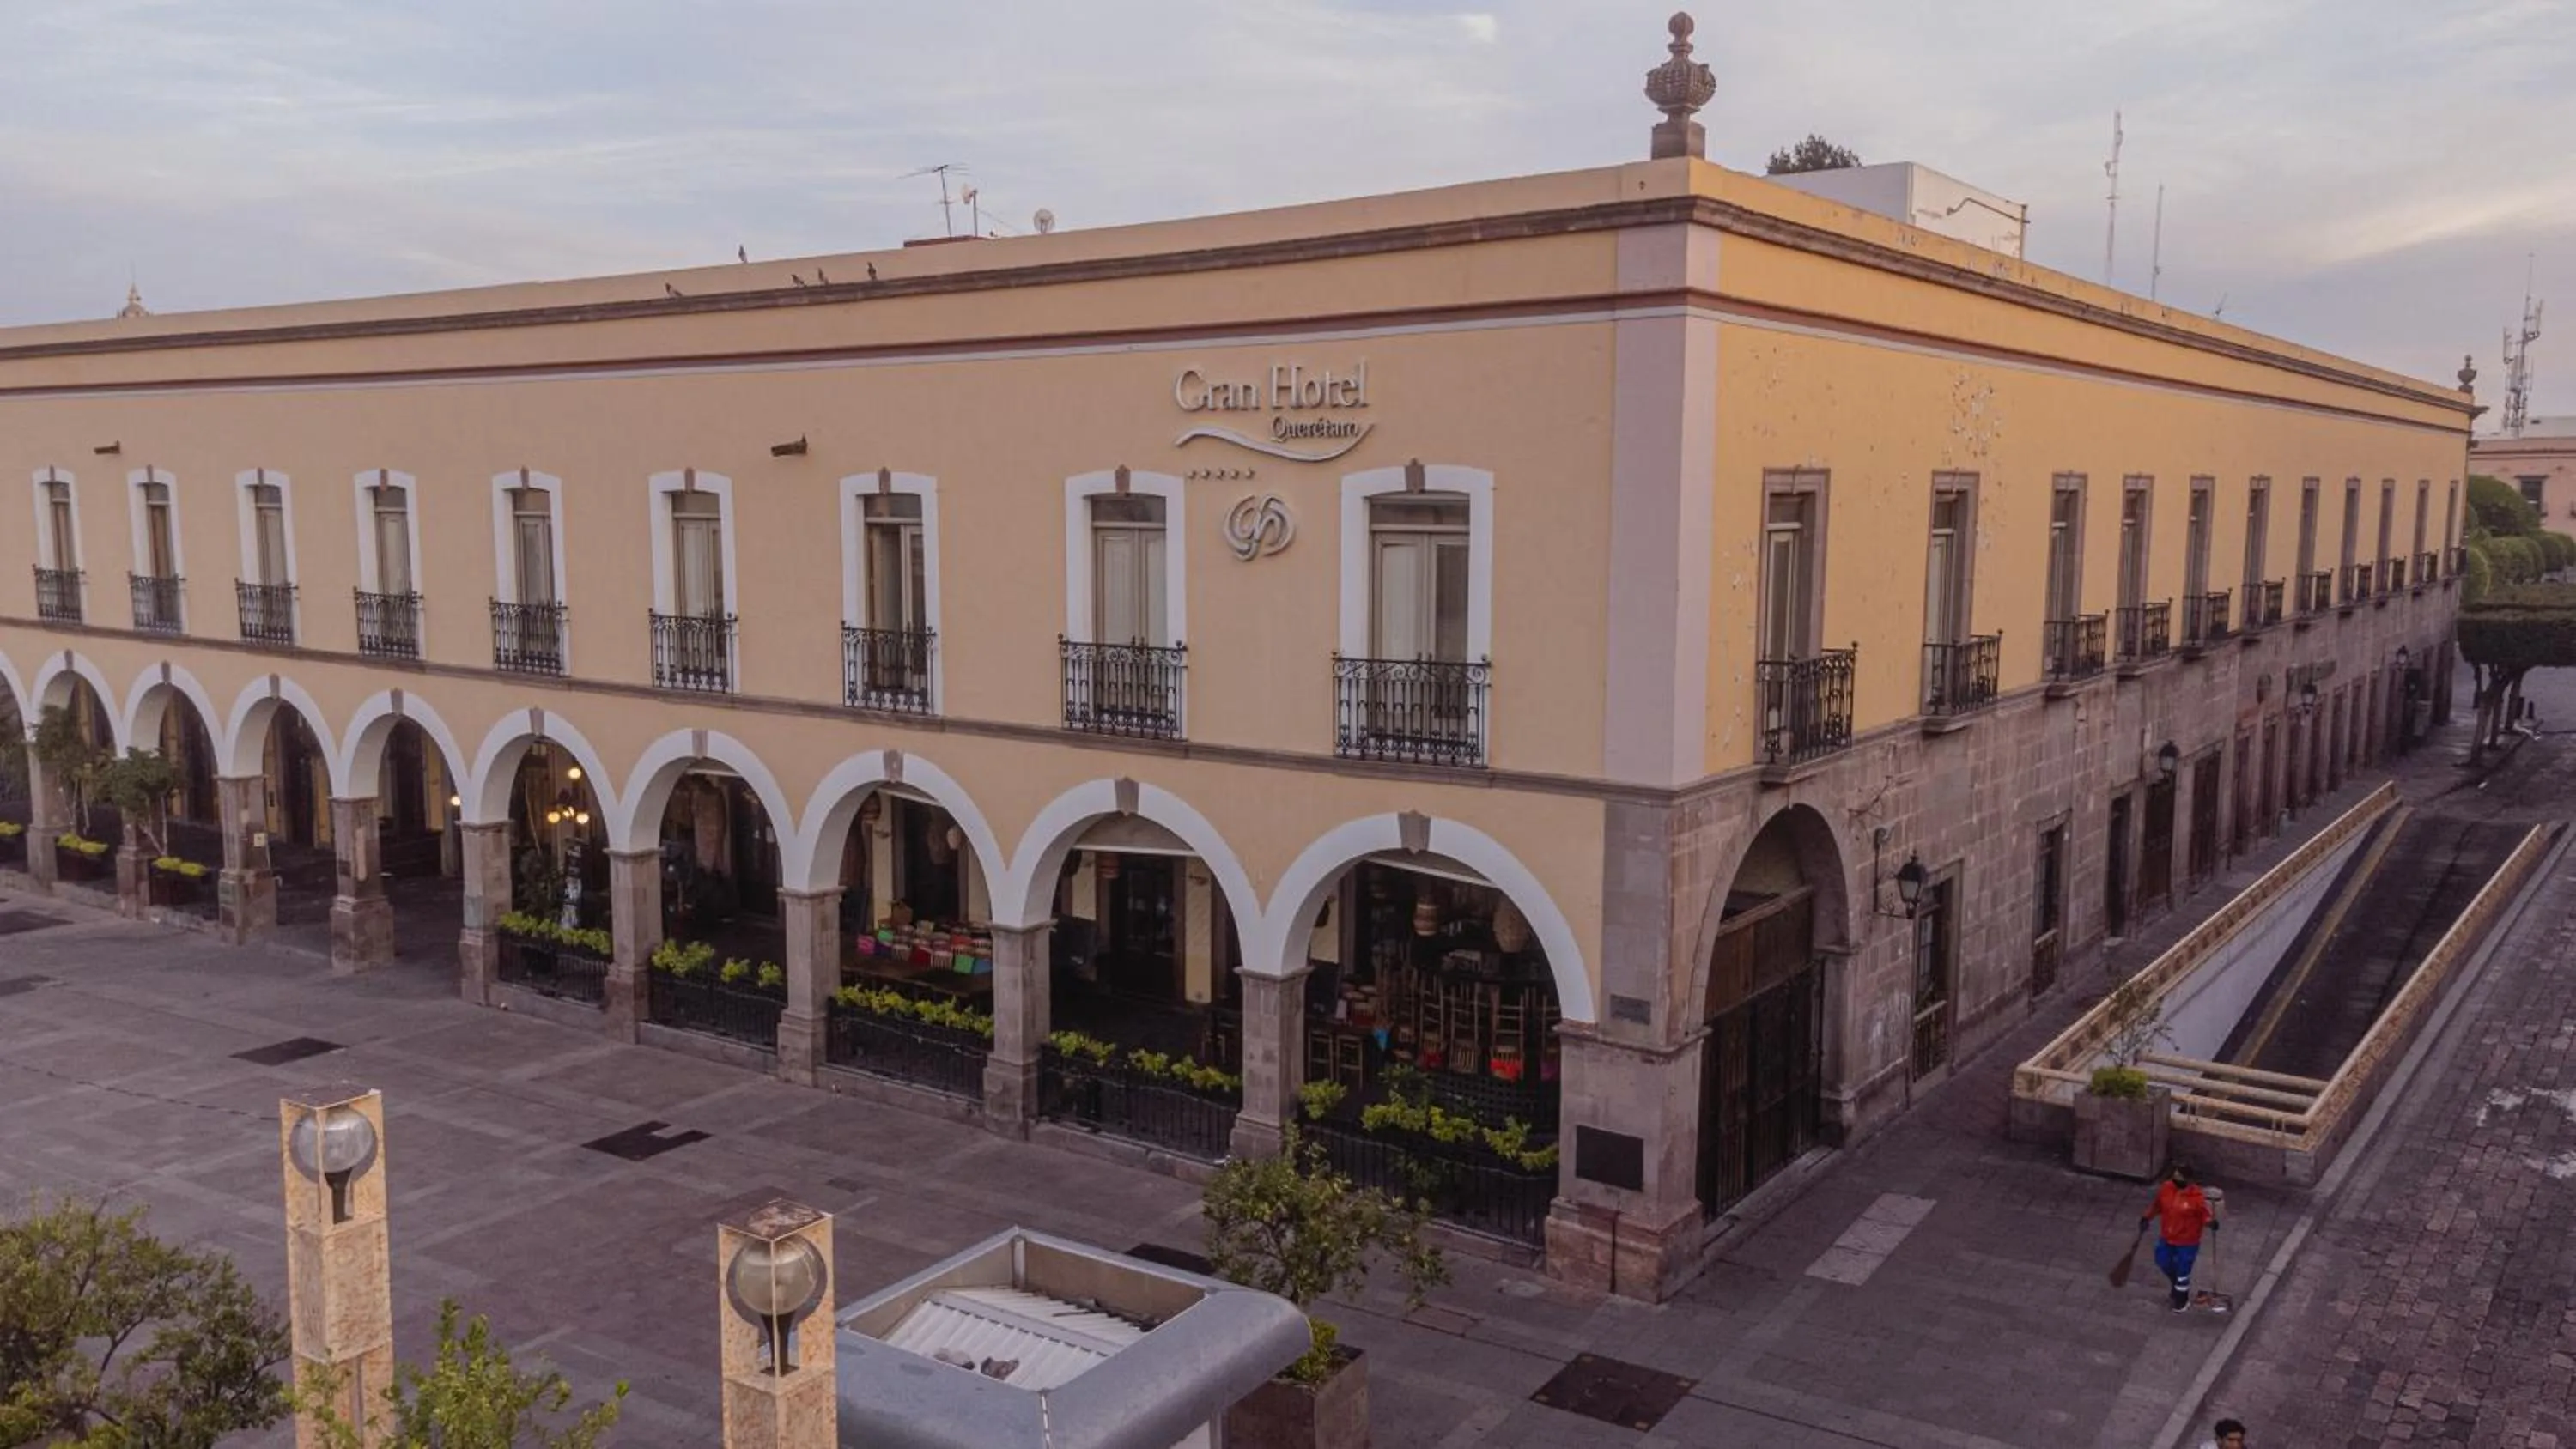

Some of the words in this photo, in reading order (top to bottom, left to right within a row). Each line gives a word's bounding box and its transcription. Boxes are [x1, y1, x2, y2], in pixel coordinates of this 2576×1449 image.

[1175, 368, 1261, 412] Gran
[1270, 359, 1369, 409] Hotel
[1271, 415, 1359, 443] Querétaro
